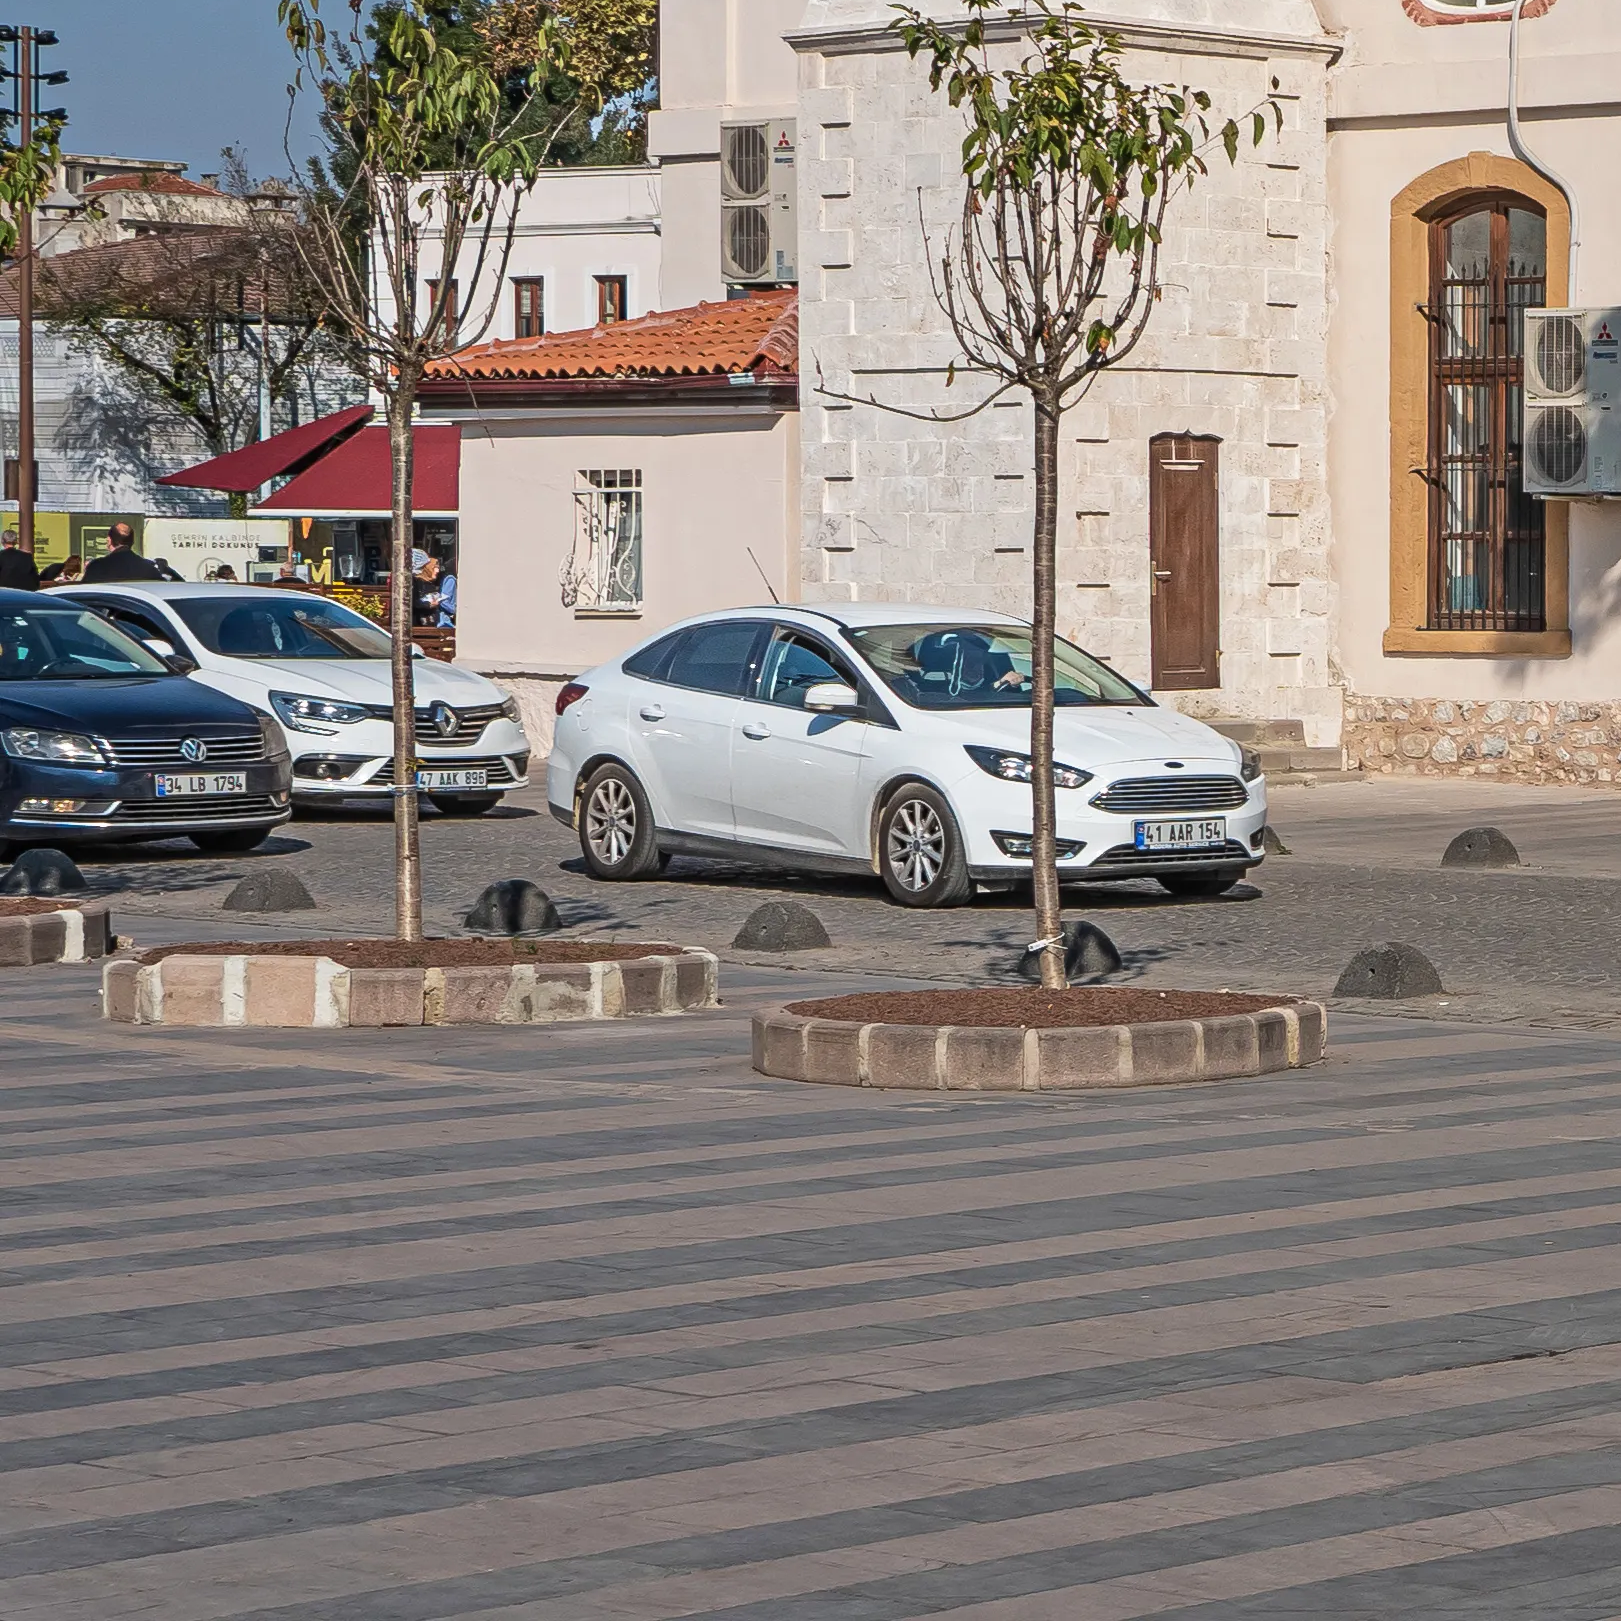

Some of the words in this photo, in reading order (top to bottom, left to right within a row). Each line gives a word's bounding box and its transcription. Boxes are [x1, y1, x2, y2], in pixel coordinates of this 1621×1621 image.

[165, 777, 182, 793] 34
[189, 776, 206, 792] LB
[213, 775, 243, 791] 1794
[439, 772, 459, 785] AAK
[465, 771, 484, 785] 896
[1146, 825, 1162, 842] 41
[1169, 823, 1193, 841] AAR
[1198, 822, 1221, 839] 154
